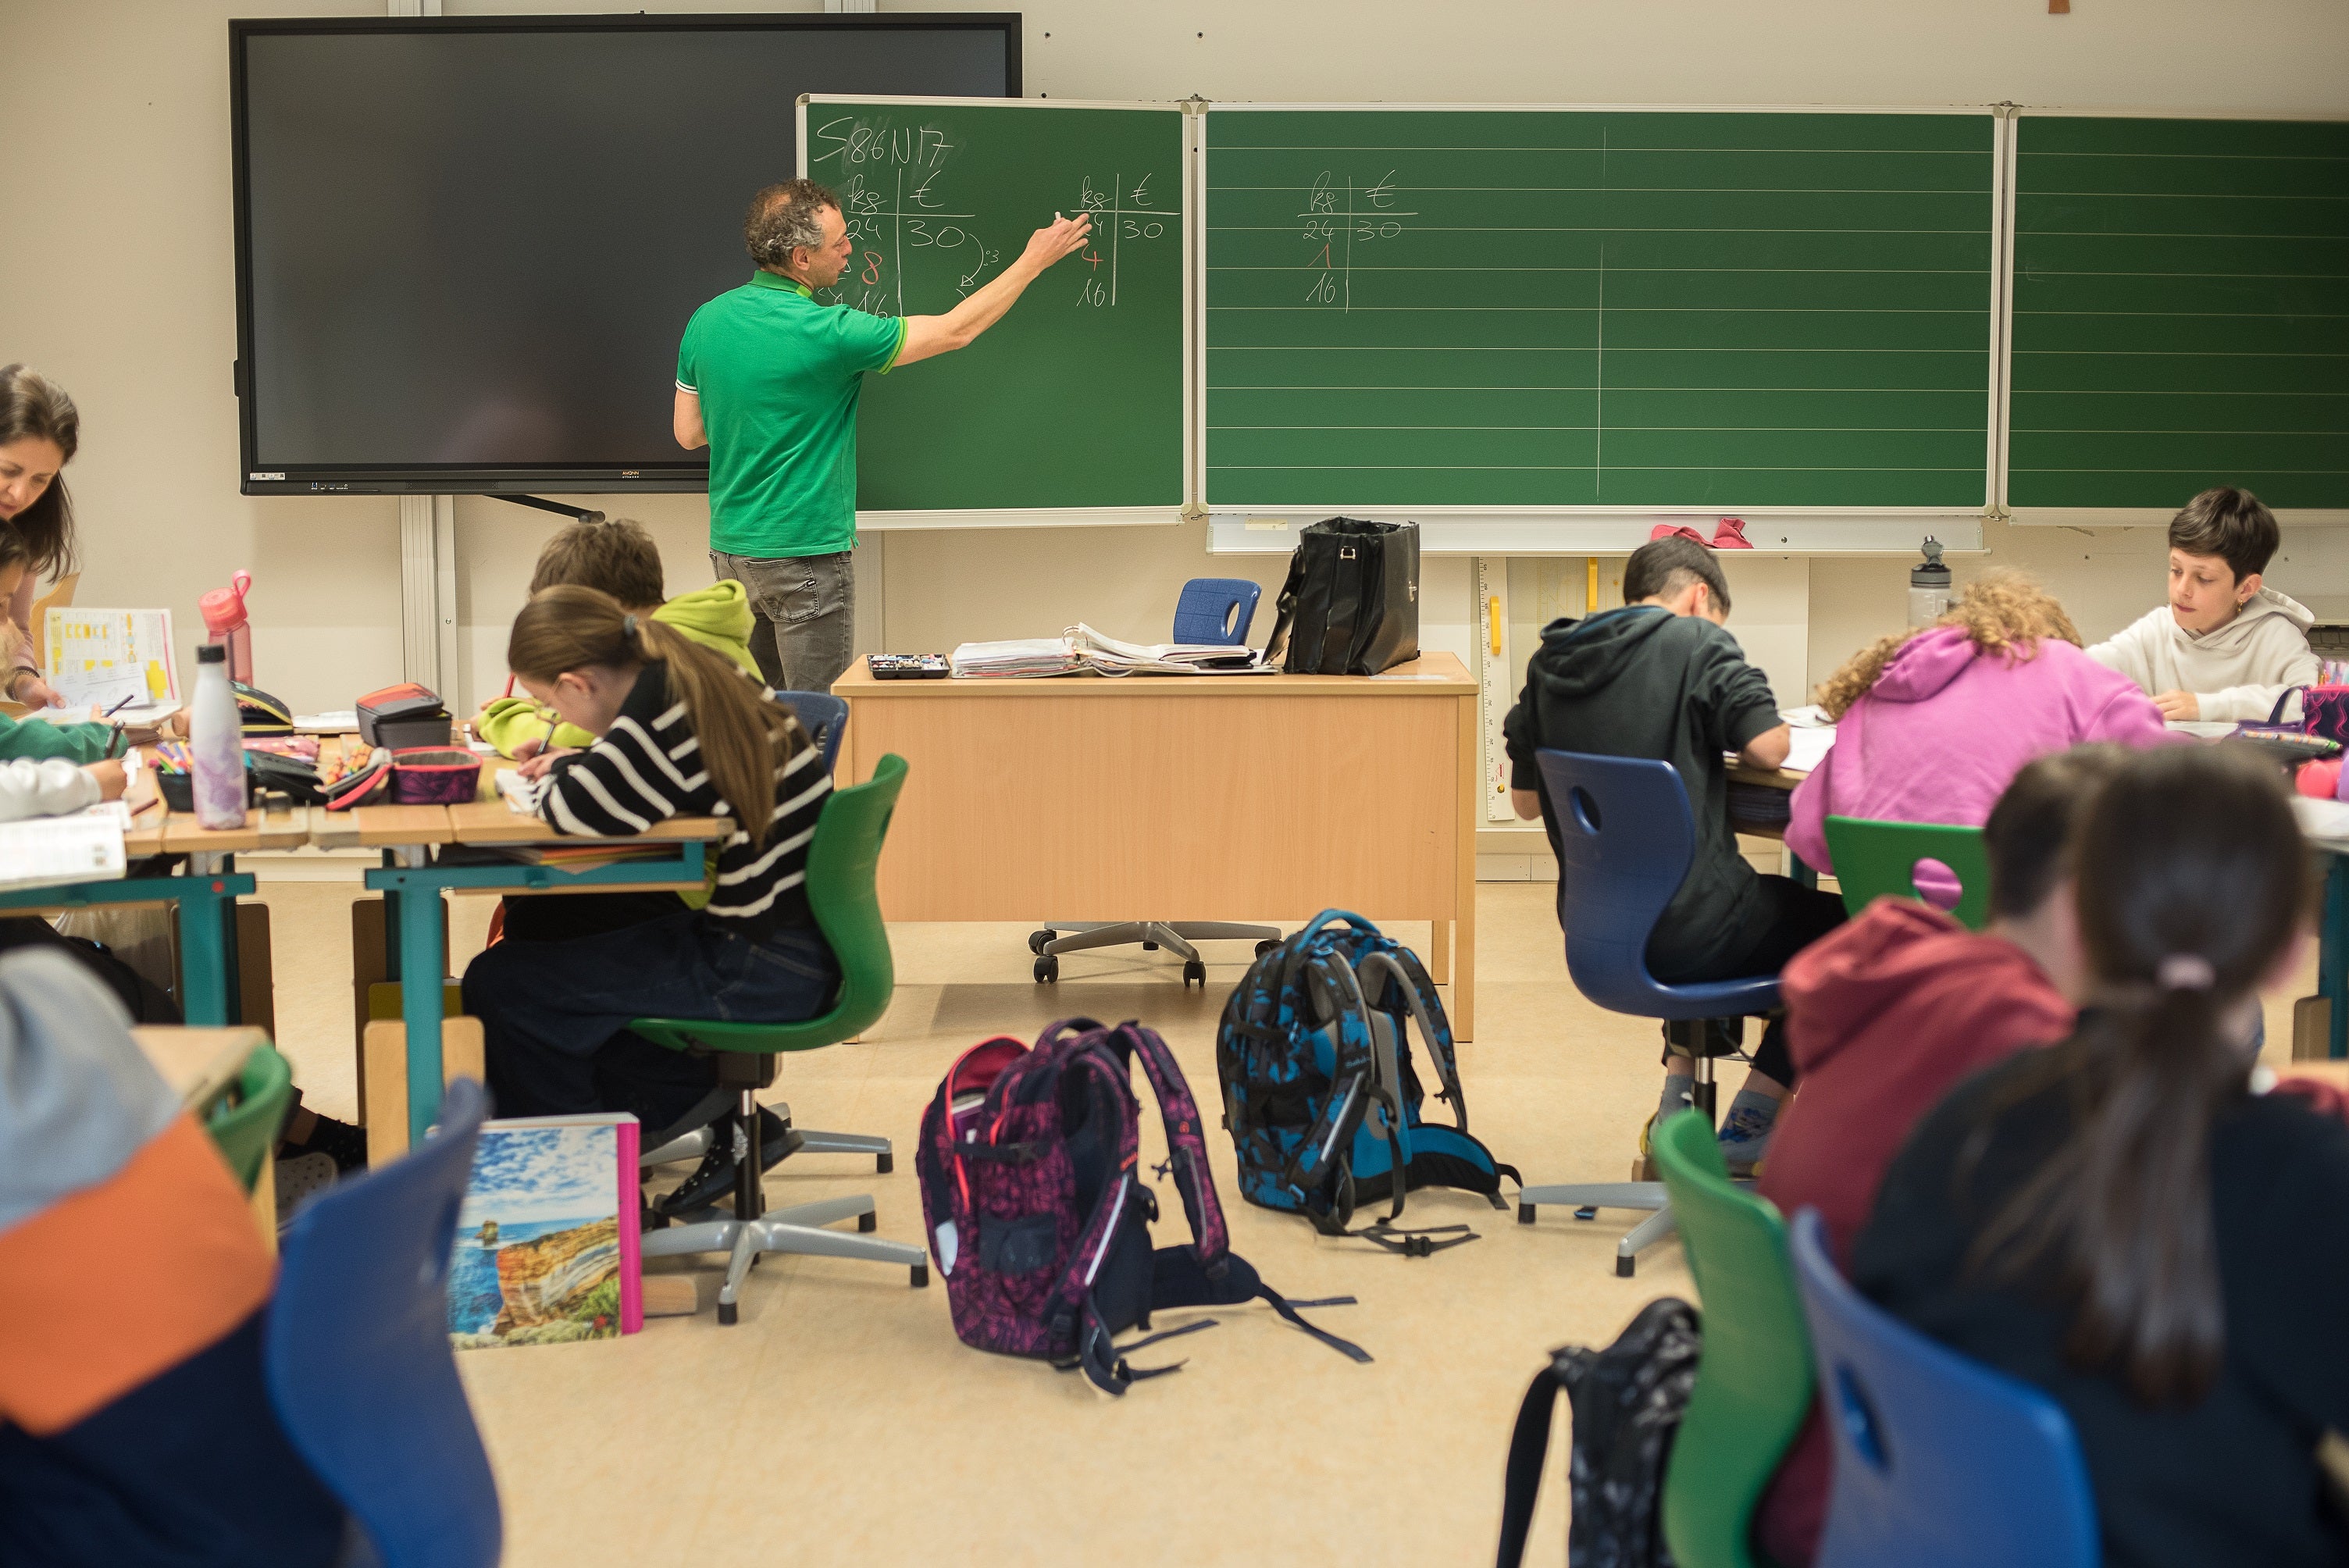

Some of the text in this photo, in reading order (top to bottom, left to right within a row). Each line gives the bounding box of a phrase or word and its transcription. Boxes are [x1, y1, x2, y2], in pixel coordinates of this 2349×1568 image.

[848, 169, 945, 215] kg €
[1081, 173, 1153, 213] kg €
[1310, 169, 1396, 215] kg €
[847, 217, 965, 248] 24 30
[1123, 220, 1164, 239] 30
[1303, 219, 1402, 243] 24 30
[861, 251, 883, 285] 8
[1082, 244, 1104, 272] 4
[1307, 242, 1331, 269] 1
[1076, 278, 1106, 307] 16
[1306, 271, 1336, 303] 16
